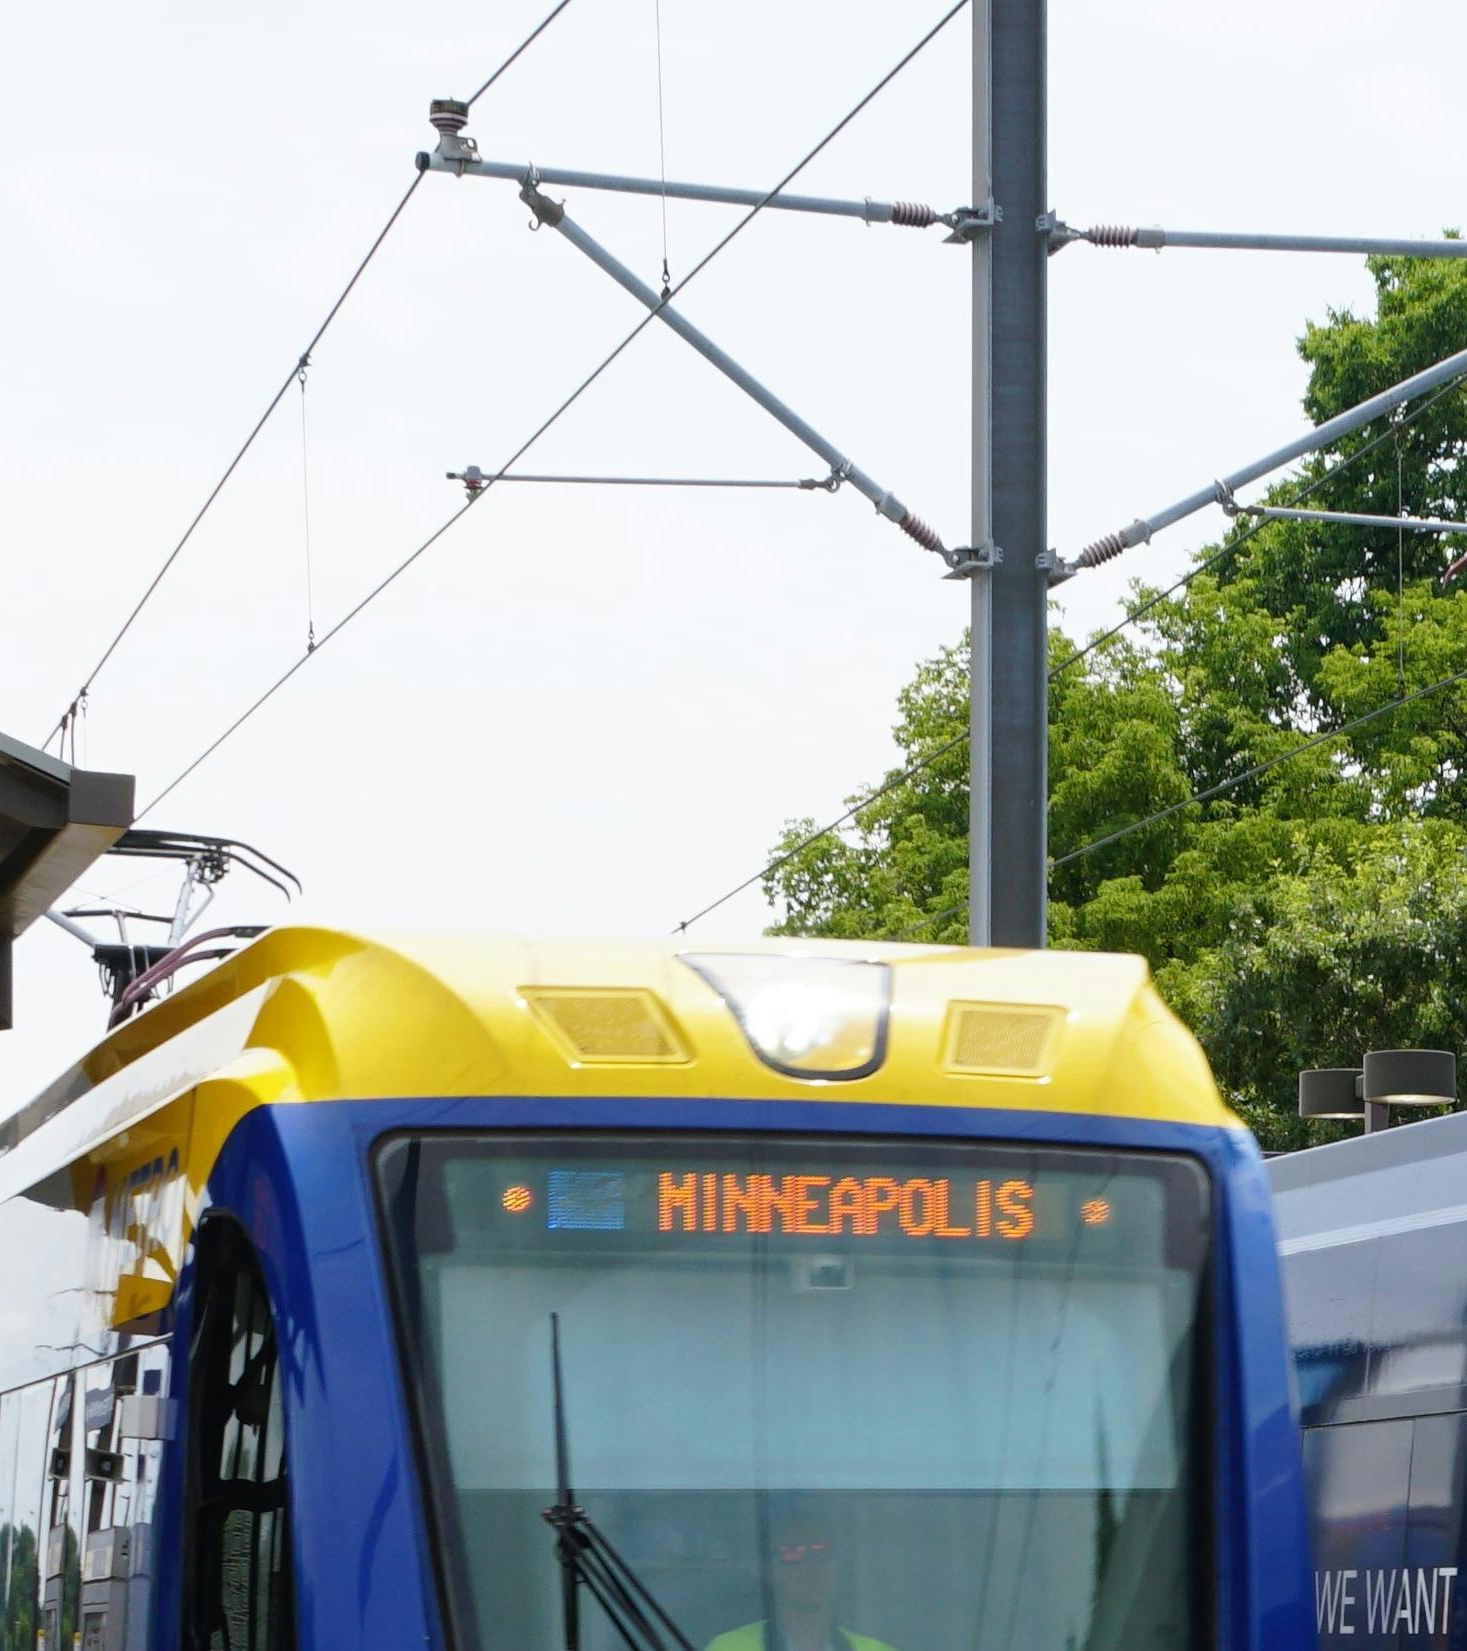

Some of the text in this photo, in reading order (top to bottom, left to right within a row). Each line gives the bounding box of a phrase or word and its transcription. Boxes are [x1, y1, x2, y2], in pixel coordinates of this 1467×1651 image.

[658, 1171, 1033, 1239] MINNEAPOLIS
[1315, 1567, 1459, 1635] WE WANT
